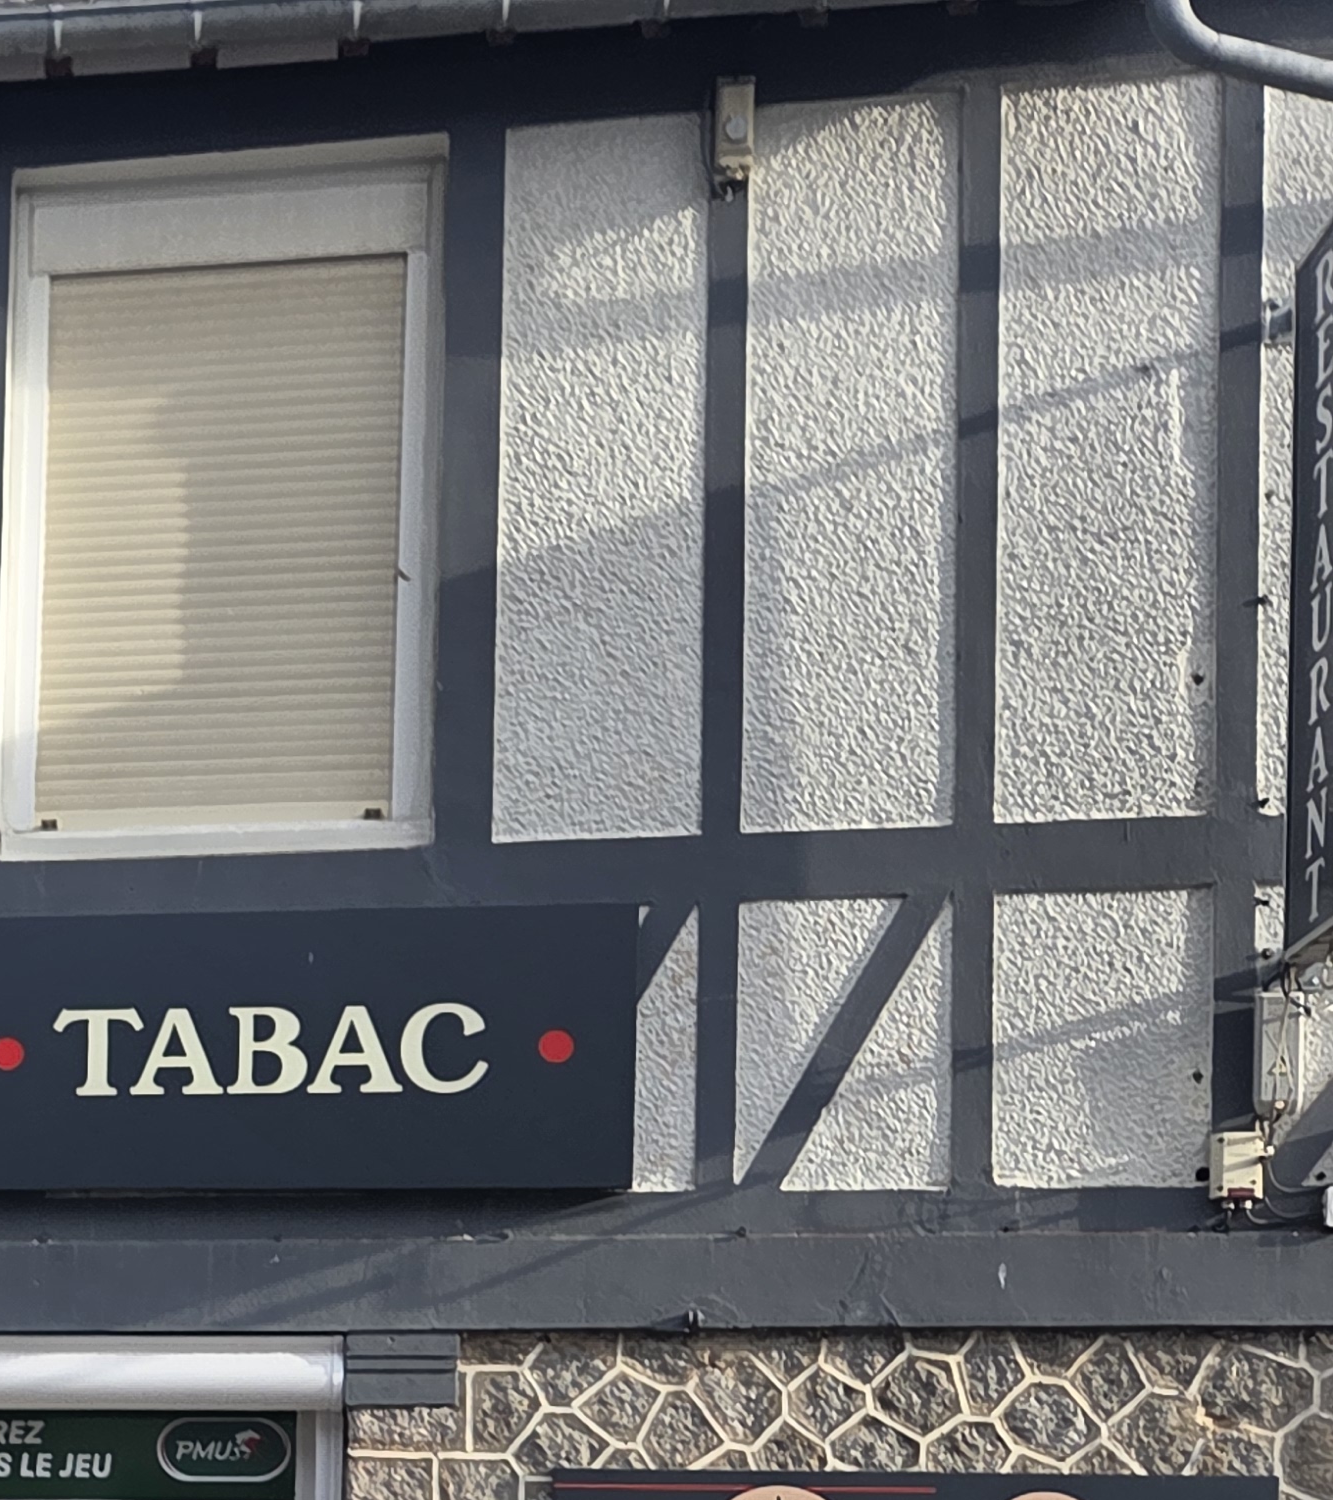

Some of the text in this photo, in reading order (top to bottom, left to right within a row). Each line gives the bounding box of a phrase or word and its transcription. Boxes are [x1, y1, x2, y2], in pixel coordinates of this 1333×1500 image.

[54, 1003, 489, 1096] TABAC
[175, 1439, 233, 1462] PMU
[20, 1453, 52, 1478] LE
[59, 1453, 113, 1479] JEU
